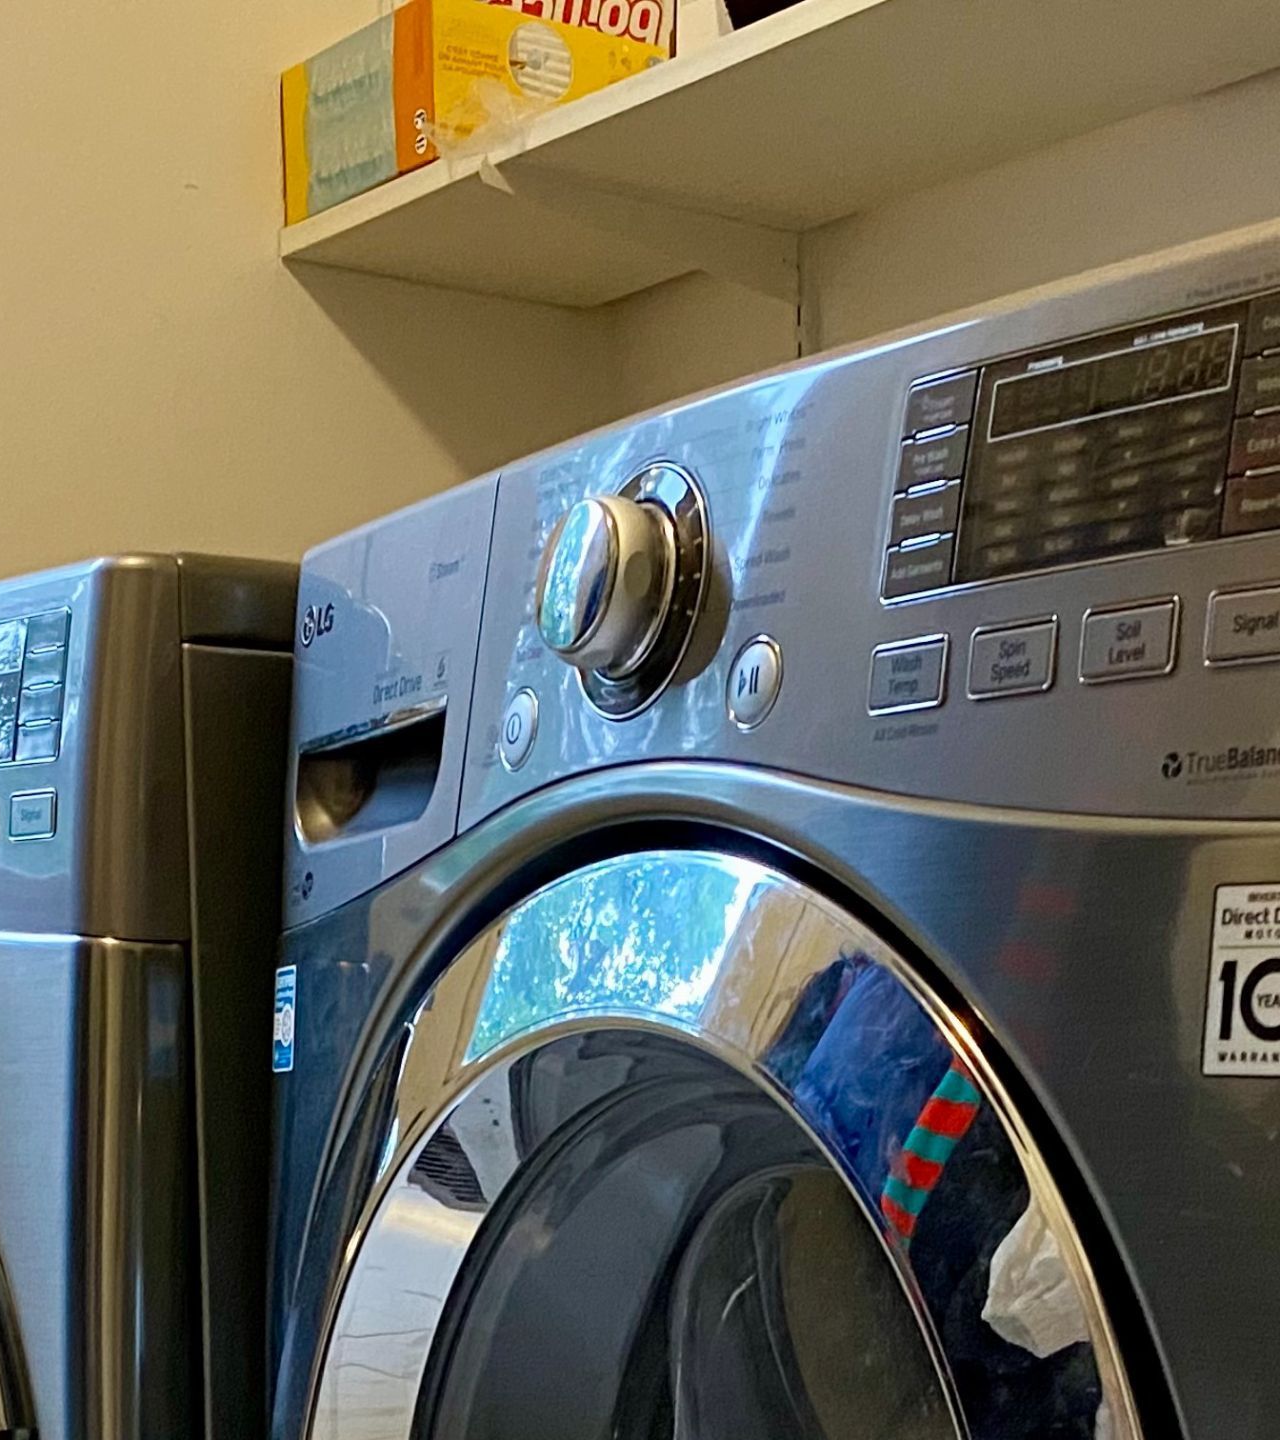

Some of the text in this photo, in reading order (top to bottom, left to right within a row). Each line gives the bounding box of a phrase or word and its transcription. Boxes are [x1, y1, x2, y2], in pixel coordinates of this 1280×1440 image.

[316, 602, 335, 637] LG
[1116, 620, 1142, 641] Soil
[1232, 611, 1280, 637] Signal
[998, 640, 1027, 661] Spin
[1108, 643, 1146, 665] Level
[990, 659, 1031, 684] Speed
[1221, 907, 1271, 926] Direct
